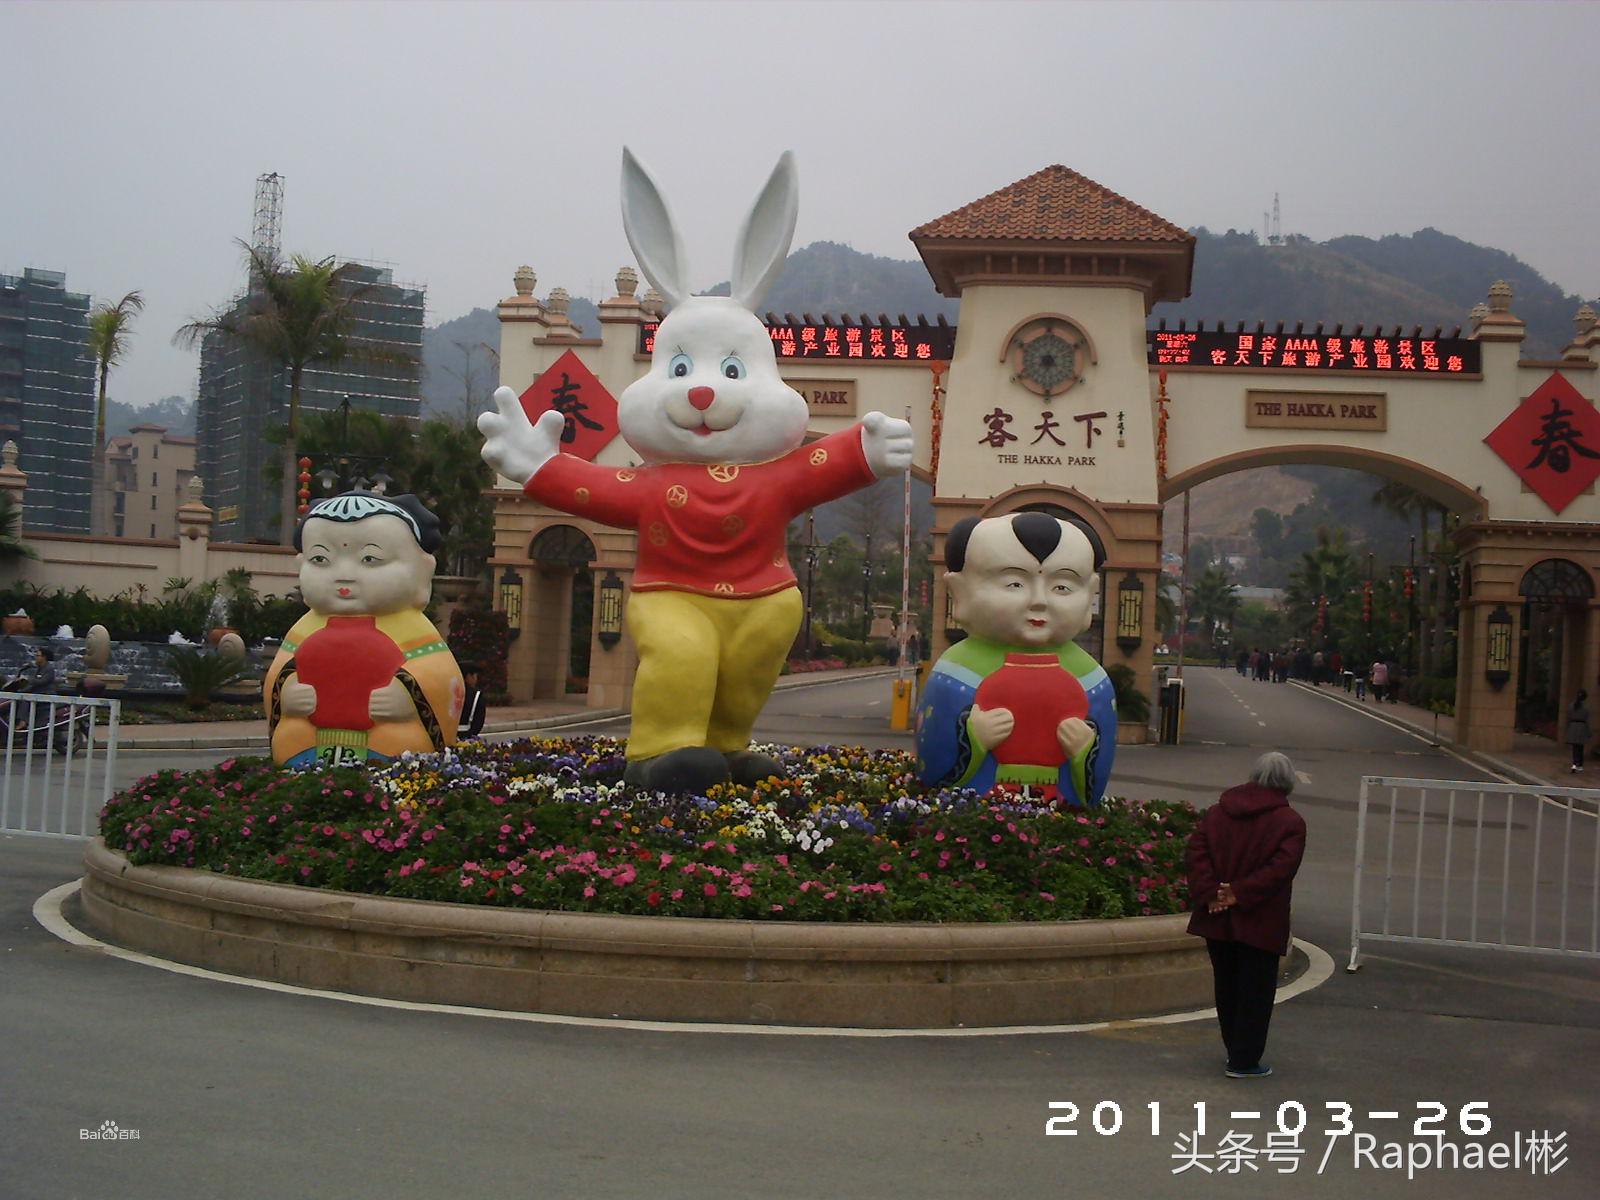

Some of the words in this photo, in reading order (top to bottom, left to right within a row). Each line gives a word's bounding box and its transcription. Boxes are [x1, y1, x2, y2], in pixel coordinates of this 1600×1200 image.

[765, 327, 906, 343] AAA级旅游景区
[1210, 349, 1464, 371] 客天下旅游产业园欢迎您
[812, 391, 849, 405] PARK
[1254, 402, 1282, 416] THE
[1286, 402, 1336, 417] HAKKA
[1340, 404, 1378, 419] PARK
[978, 407, 1108, 449] 客天下
[1525, 398, 1600, 474] 春
[997, 454, 1019, 464] THE
[1024, 455, 1062, 465] HAKKA
[1068, 456, 1096, 466] PARK
